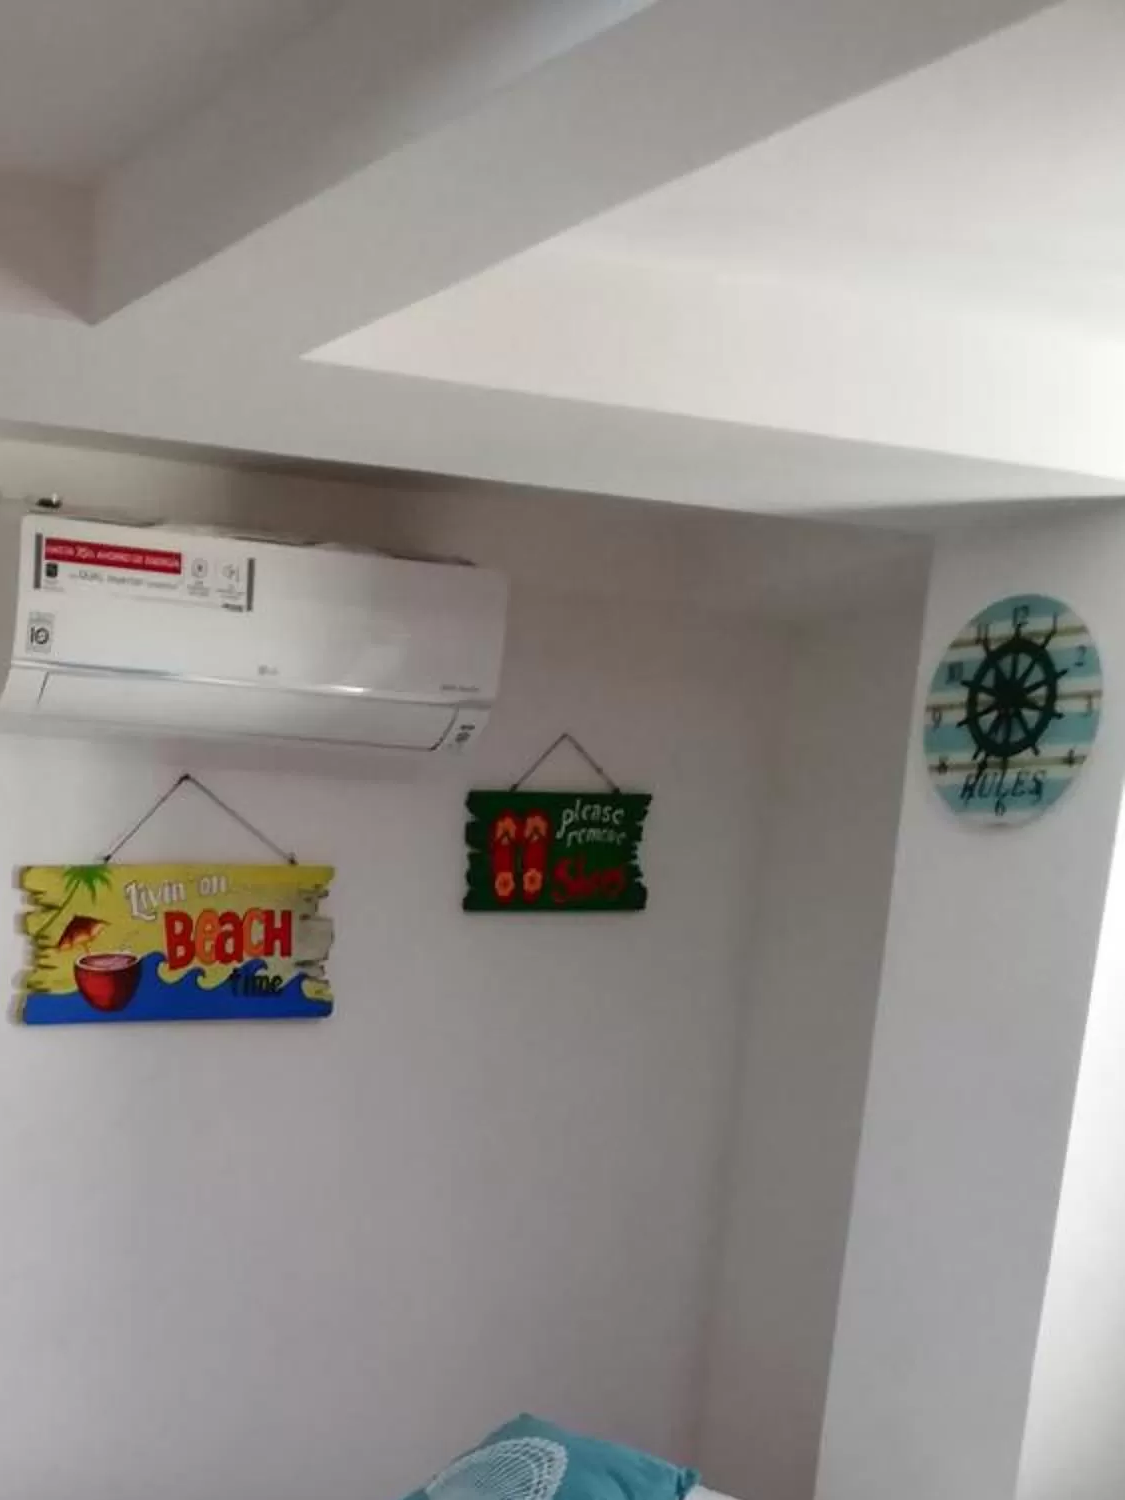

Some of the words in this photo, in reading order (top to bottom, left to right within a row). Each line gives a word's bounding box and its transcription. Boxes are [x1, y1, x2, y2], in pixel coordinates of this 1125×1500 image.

[555, 798, 625, 840] please
[566, 827, 627, 847] remove
[125, 878, 187, 922] Livin
[199, 874, 229, 897] on
